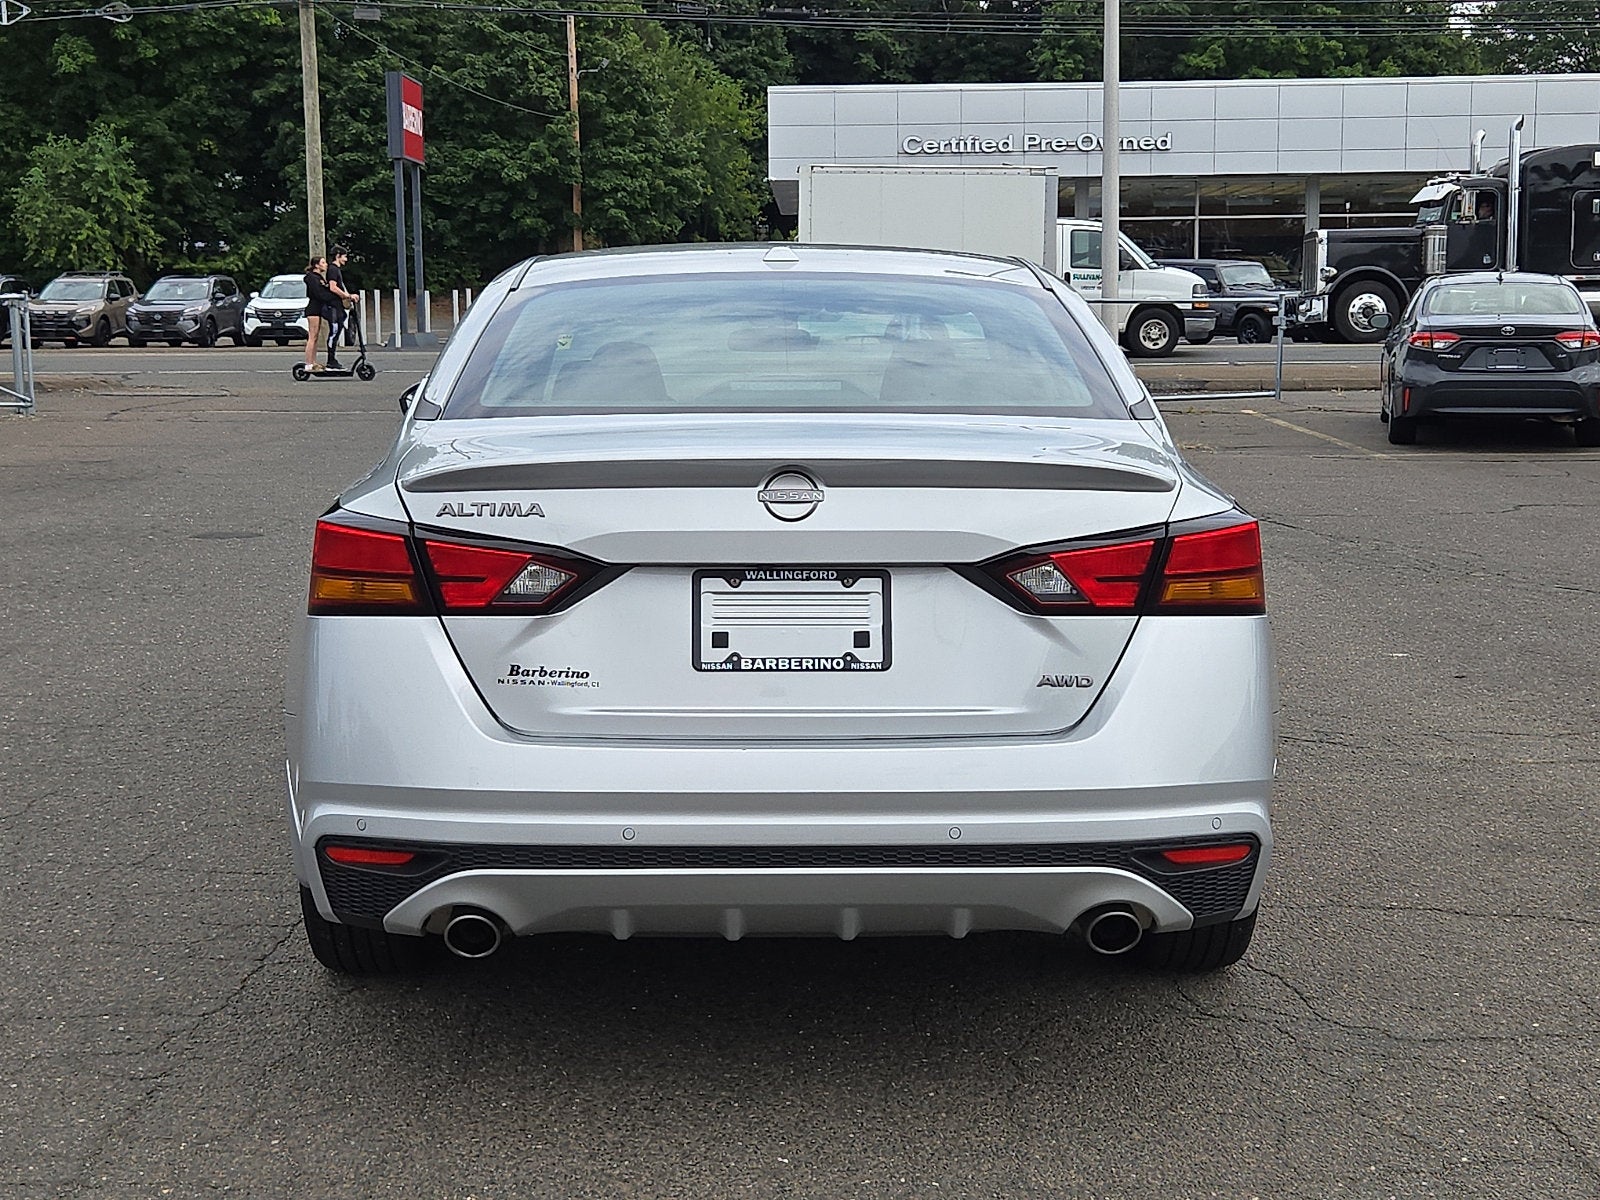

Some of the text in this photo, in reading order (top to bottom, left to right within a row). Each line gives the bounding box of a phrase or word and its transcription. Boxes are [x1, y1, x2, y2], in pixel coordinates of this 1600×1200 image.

[902, 135, 1013, 153] Certified
[760, 492, 822, 500] NISSAN
[436, 502, 545, 517] ALTIMA
[745, 570, 838, 580] WALLINGFORD
[702, 658, 882, 670] NISSAN BARBERINO NISSAN
[507, 664, 590, 679] Barberino
[1036, 674, 1094, 688] AWD
